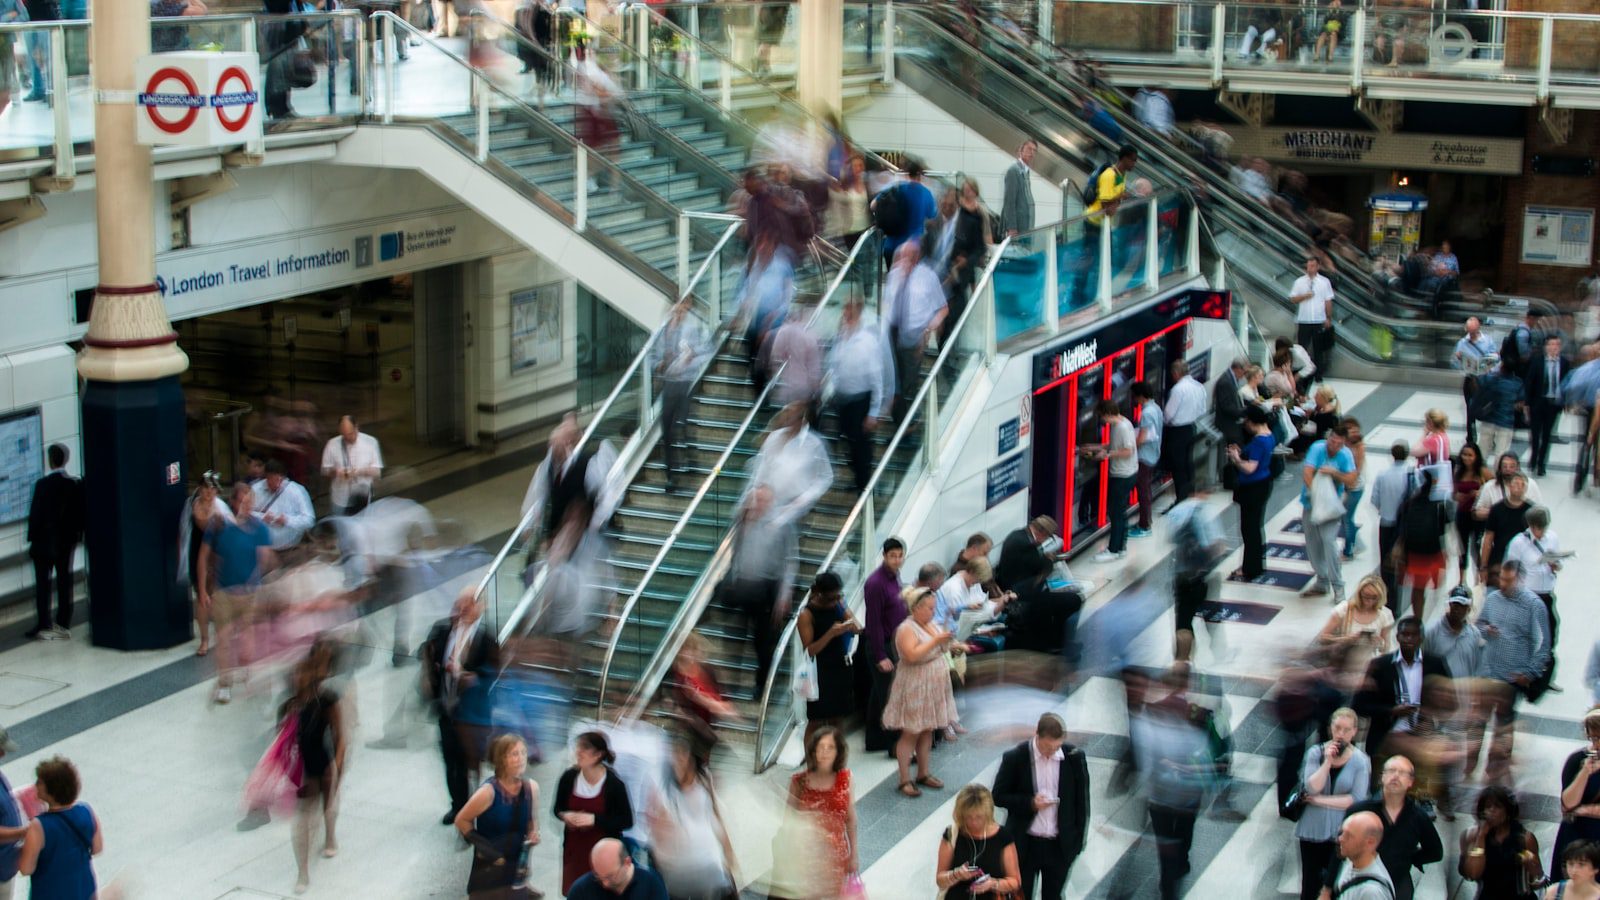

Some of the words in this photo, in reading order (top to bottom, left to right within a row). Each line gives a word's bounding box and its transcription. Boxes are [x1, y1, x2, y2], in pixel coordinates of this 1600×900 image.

[142, 95, 203, 105] UNDERGROUND
[213, 93, 257, 104] UNDERGROUND
[1284, 130, 1376, 151] MERCHANT
[171, 271, 224, 295] London
[229, 259, 272, 283] Travel
[276, 247, 351, 276] Information
[1063, 338, 1098, 376] NatWest
